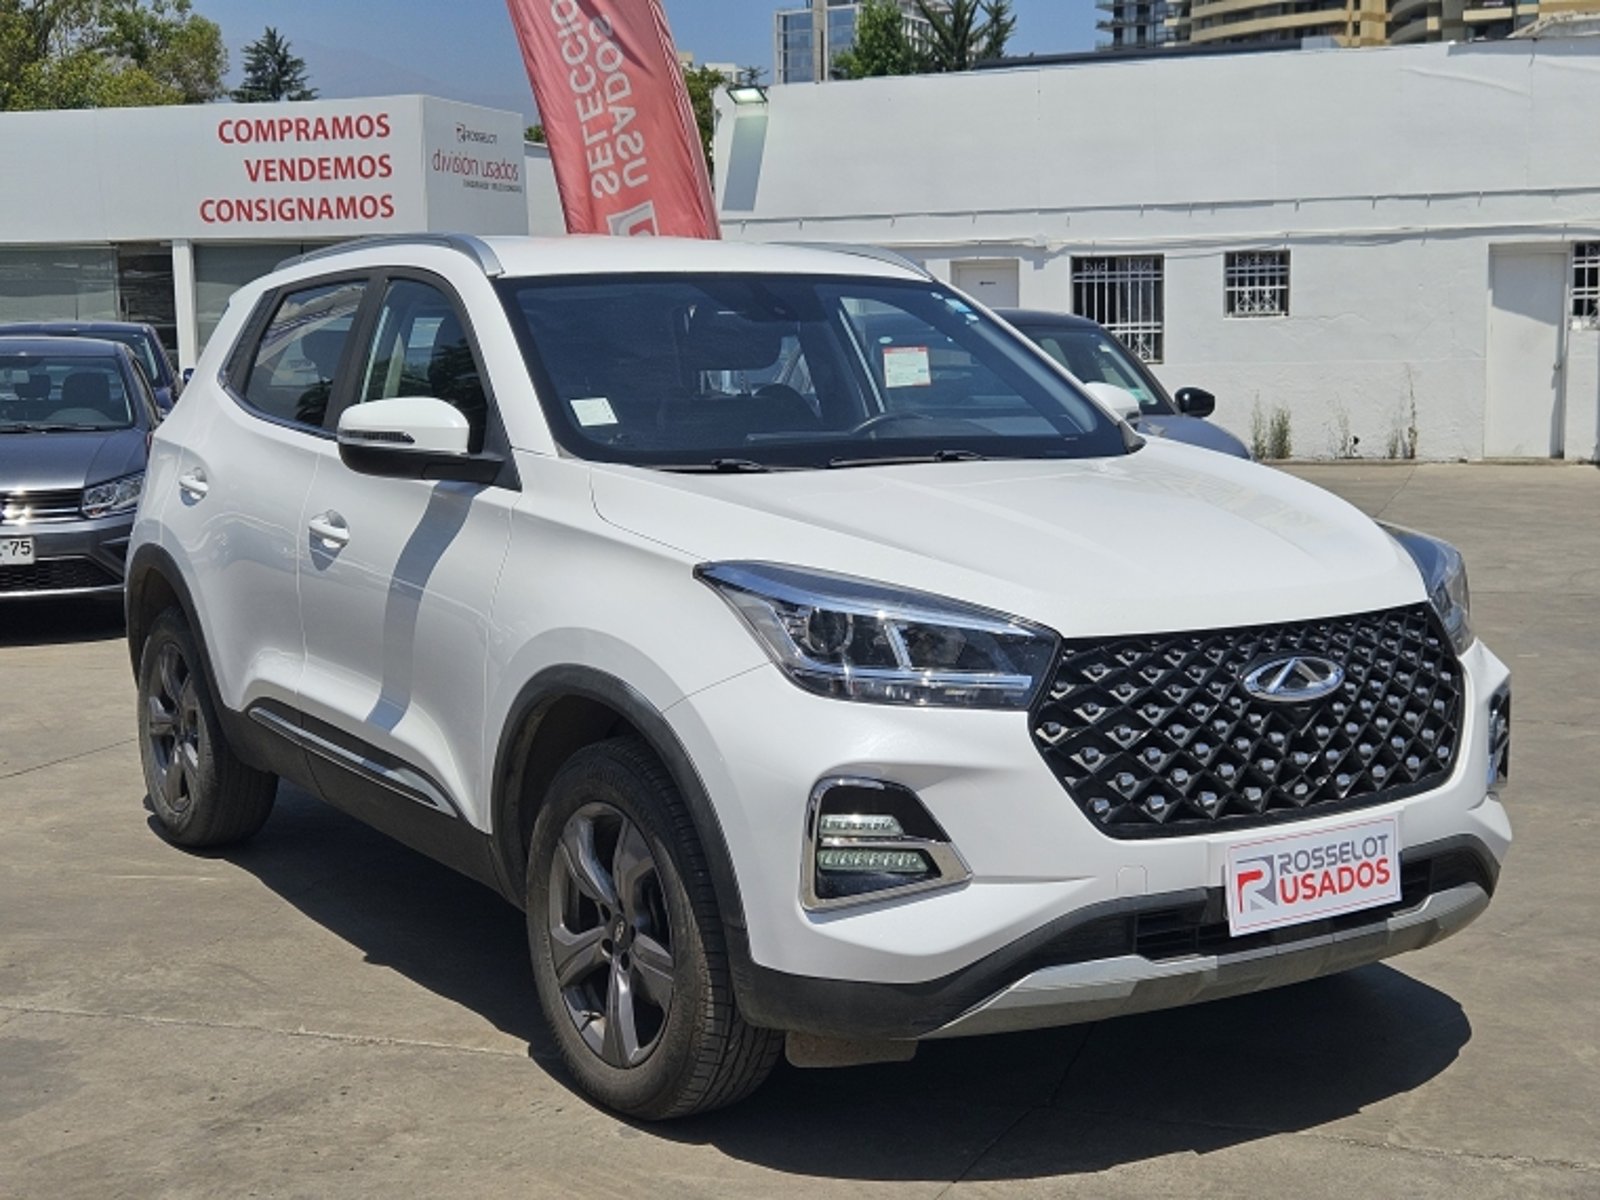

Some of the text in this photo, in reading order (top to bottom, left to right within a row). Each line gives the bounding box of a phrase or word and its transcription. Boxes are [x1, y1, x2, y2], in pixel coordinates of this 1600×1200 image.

[218, 113, 390, 144] COMPRAMOS
[244, 154, 392, 182] VENDEMOS
[482, 157, 519, 181] usados
[200, 194, 394, 223] CONSIGNAMOS
[1277, 835, 1388, 875] ROSSELOT
[1279, 858, 1391, 904] USADOS
